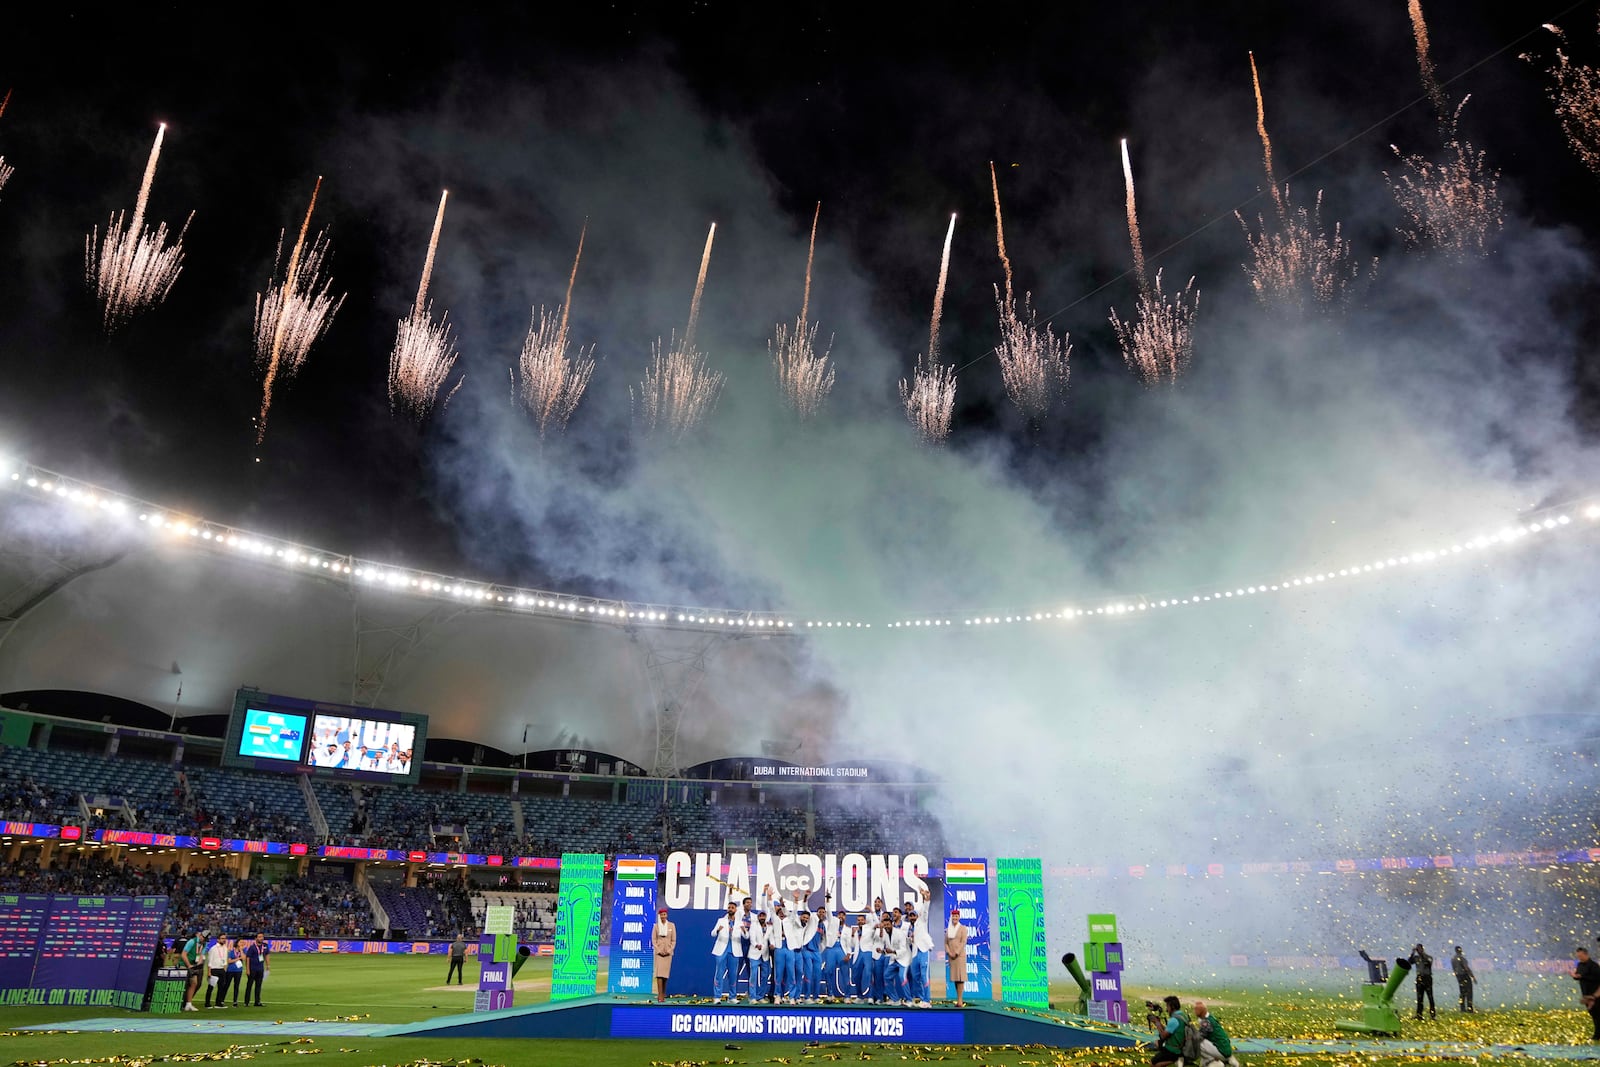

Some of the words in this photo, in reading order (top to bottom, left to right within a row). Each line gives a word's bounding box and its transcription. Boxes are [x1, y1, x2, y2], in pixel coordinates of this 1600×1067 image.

[754, 766, 775, 776] DUBAI
[779, 767, 835, 777] INTERNATIONAL
[837, 768, 868, 777] STADIUM
[3, 821, 34, 836] INDIA
[154, 833, 177, 846] 2025
[562, 854, 604, 865] CHAMPIONS
[997, 858, 1042, 870] CHAMPIONS
[560, 868, 603, 879] CHAMPIONS
[998, 873, 1042, 884] CHAMPIONS
[665, 851, 929, 912] CHAMPIONS
[780, 876, 810, 891] ICC
[625, 887, 645, 898] INDIA
[956, 890, 977, 901] INDIA
[624, 904, 644, 915] INDIA
[623, 922, 643, 933] INDIA
[270, 940, 292, 952] 2025
[362, 941, 388, 954] INDIA
[622, 940, 642, 951] INDIA
[621, 958, 641, 969] INDIA
[483, 971, 504, 983] FINAL
[620, 976, 640, 988] INDIA
[165, 980, 187, 992] FINAL
[552, 983, 597, 996] CHAMPIONS
[1095, 979, 1118, 991] FINAL
[26, 989, 46, 1005] ALL
[48, 989, 66, 1005] ON
[68, 989, 89, 1005] THE
[89, 989, 114, 1005] LINE
[163, 991, 184, 1003] FINAL
[1003, 991, 1049, 1003] CHAMPIONS
[161, 1002, 181, 1014] FINAL
[671, 1014, 692, 1033] ICC
[694, 1014, 764, 1034] CHAMPIONS
[766, 1015, 812, 1035] TROPHY
[814, 1016, 871, 1036] PAKISTAN
[874, 1017, 903, 1037] 2025
